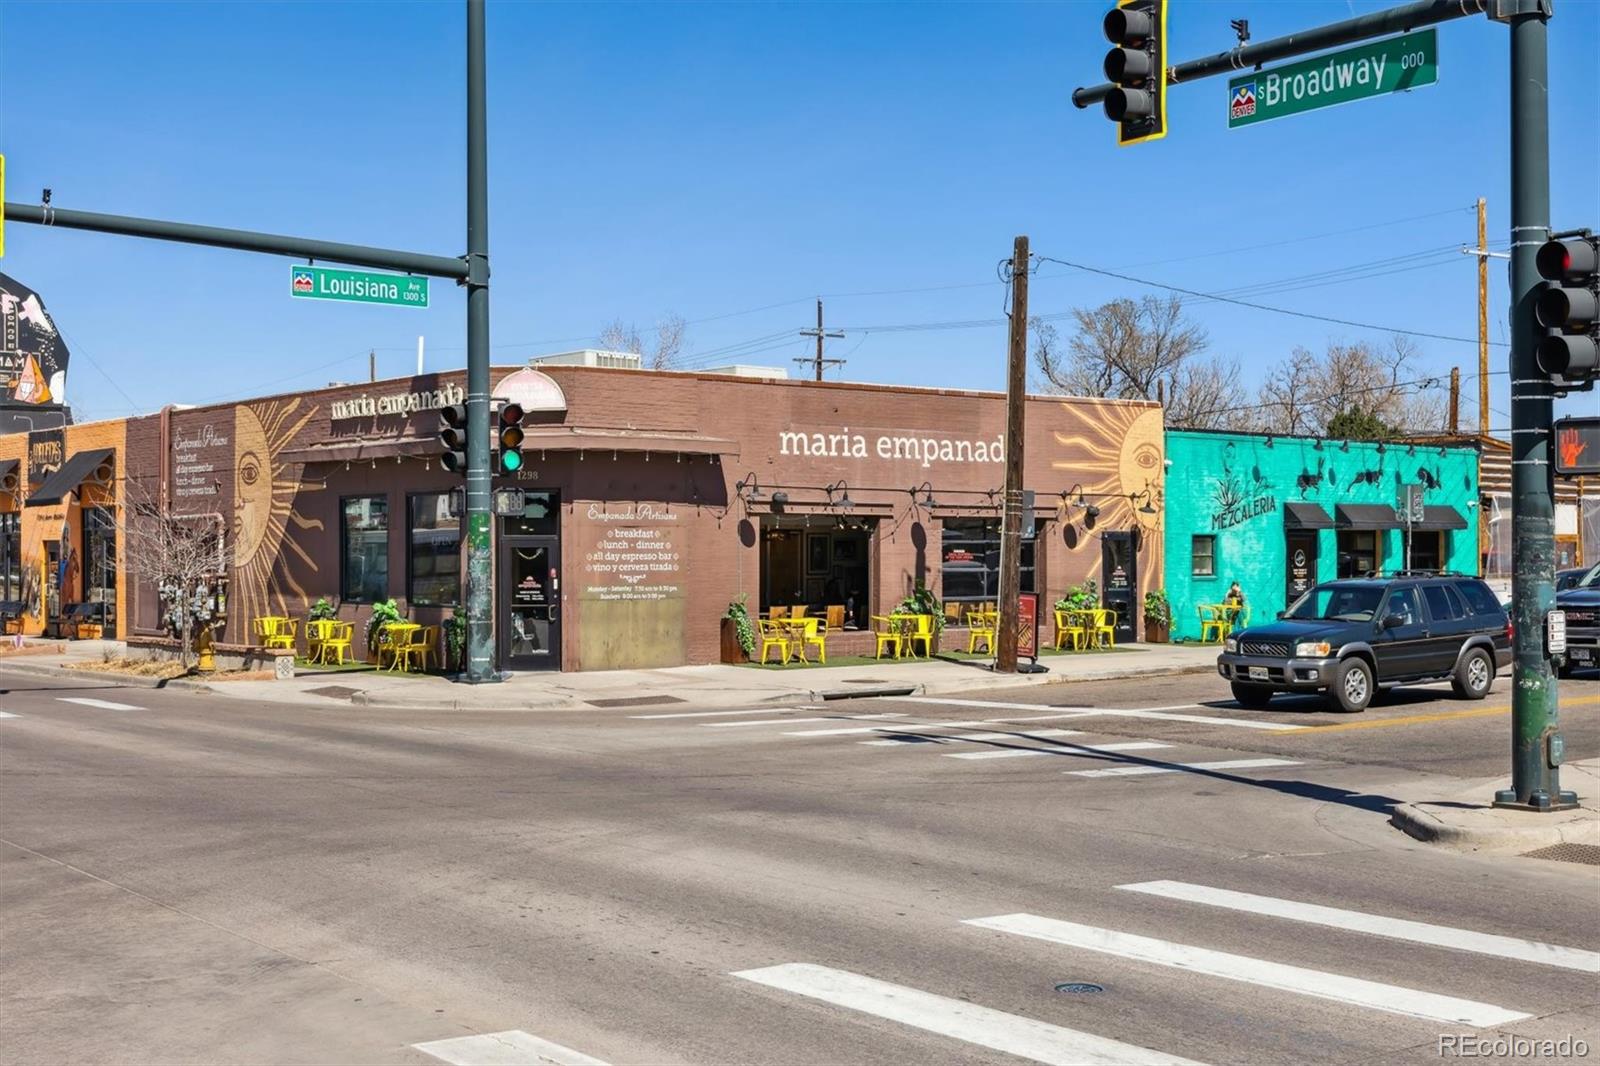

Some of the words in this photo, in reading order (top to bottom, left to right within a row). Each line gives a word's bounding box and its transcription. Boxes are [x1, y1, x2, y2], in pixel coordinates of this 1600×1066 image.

[1258, 86, 1265, 100] S
[1266, 54, 1387, 106] Broadway
[1401, 51, 1425, 70] 000
[1231, 104, 1256, 119] DENVER
[320, 273, 398, 300] Louisiana
[408, 282, 420, 291] Ave
[403, 292, 419, 301] 1300
[331, 394, 376, 420] maria
[377, 382, 463, 418] empanada
[779, 427, 868, 457] maria
[876, 435, 1006, 467] empanad
[517, 471, 538, 480] 1298
[588, 503, 635, 522] Empanada
[636, 503, 677, 520] Artisans
[1212, 495, 1276, 531] MEZCALERIA
[615, 528, 654, 538] breakfast
[603, 540, 628, 549] lunch
[636, 540, 664, 549] dinner
[593, 552, 603, 560] all
[604, 552, 620, 562] day
[621, 553, 657, 562] espresso
[658, 552, 672, 560] bar
[649, 563, 672, 571] tirada
